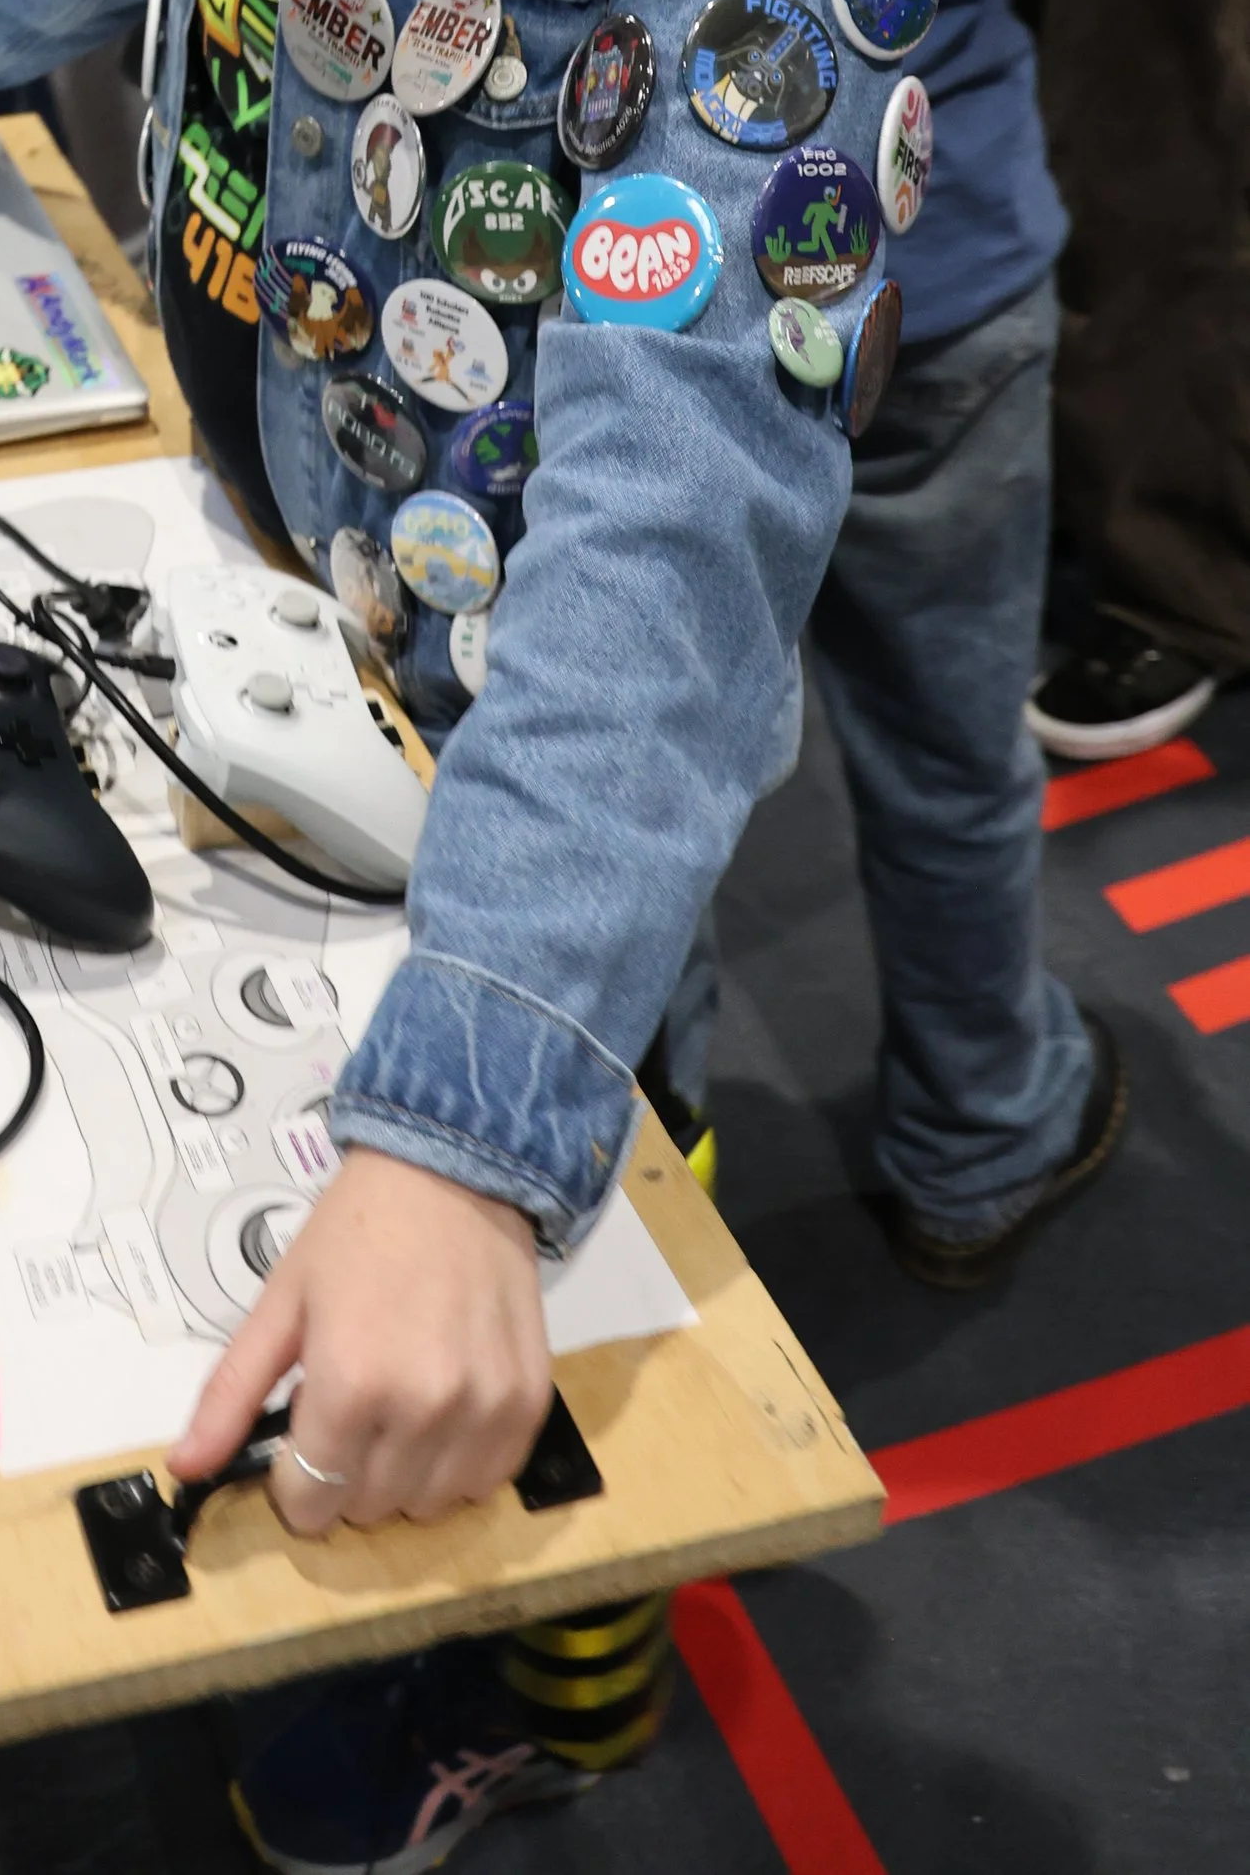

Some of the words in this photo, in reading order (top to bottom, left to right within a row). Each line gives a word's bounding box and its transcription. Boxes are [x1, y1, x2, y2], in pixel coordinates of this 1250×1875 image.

[408, 1, 493, 57] EMBER
[797, 162, 848, 177] 1002
[182, 211, 261, 324] 418
[783, 263, 857, 286] REEFSCAPE
